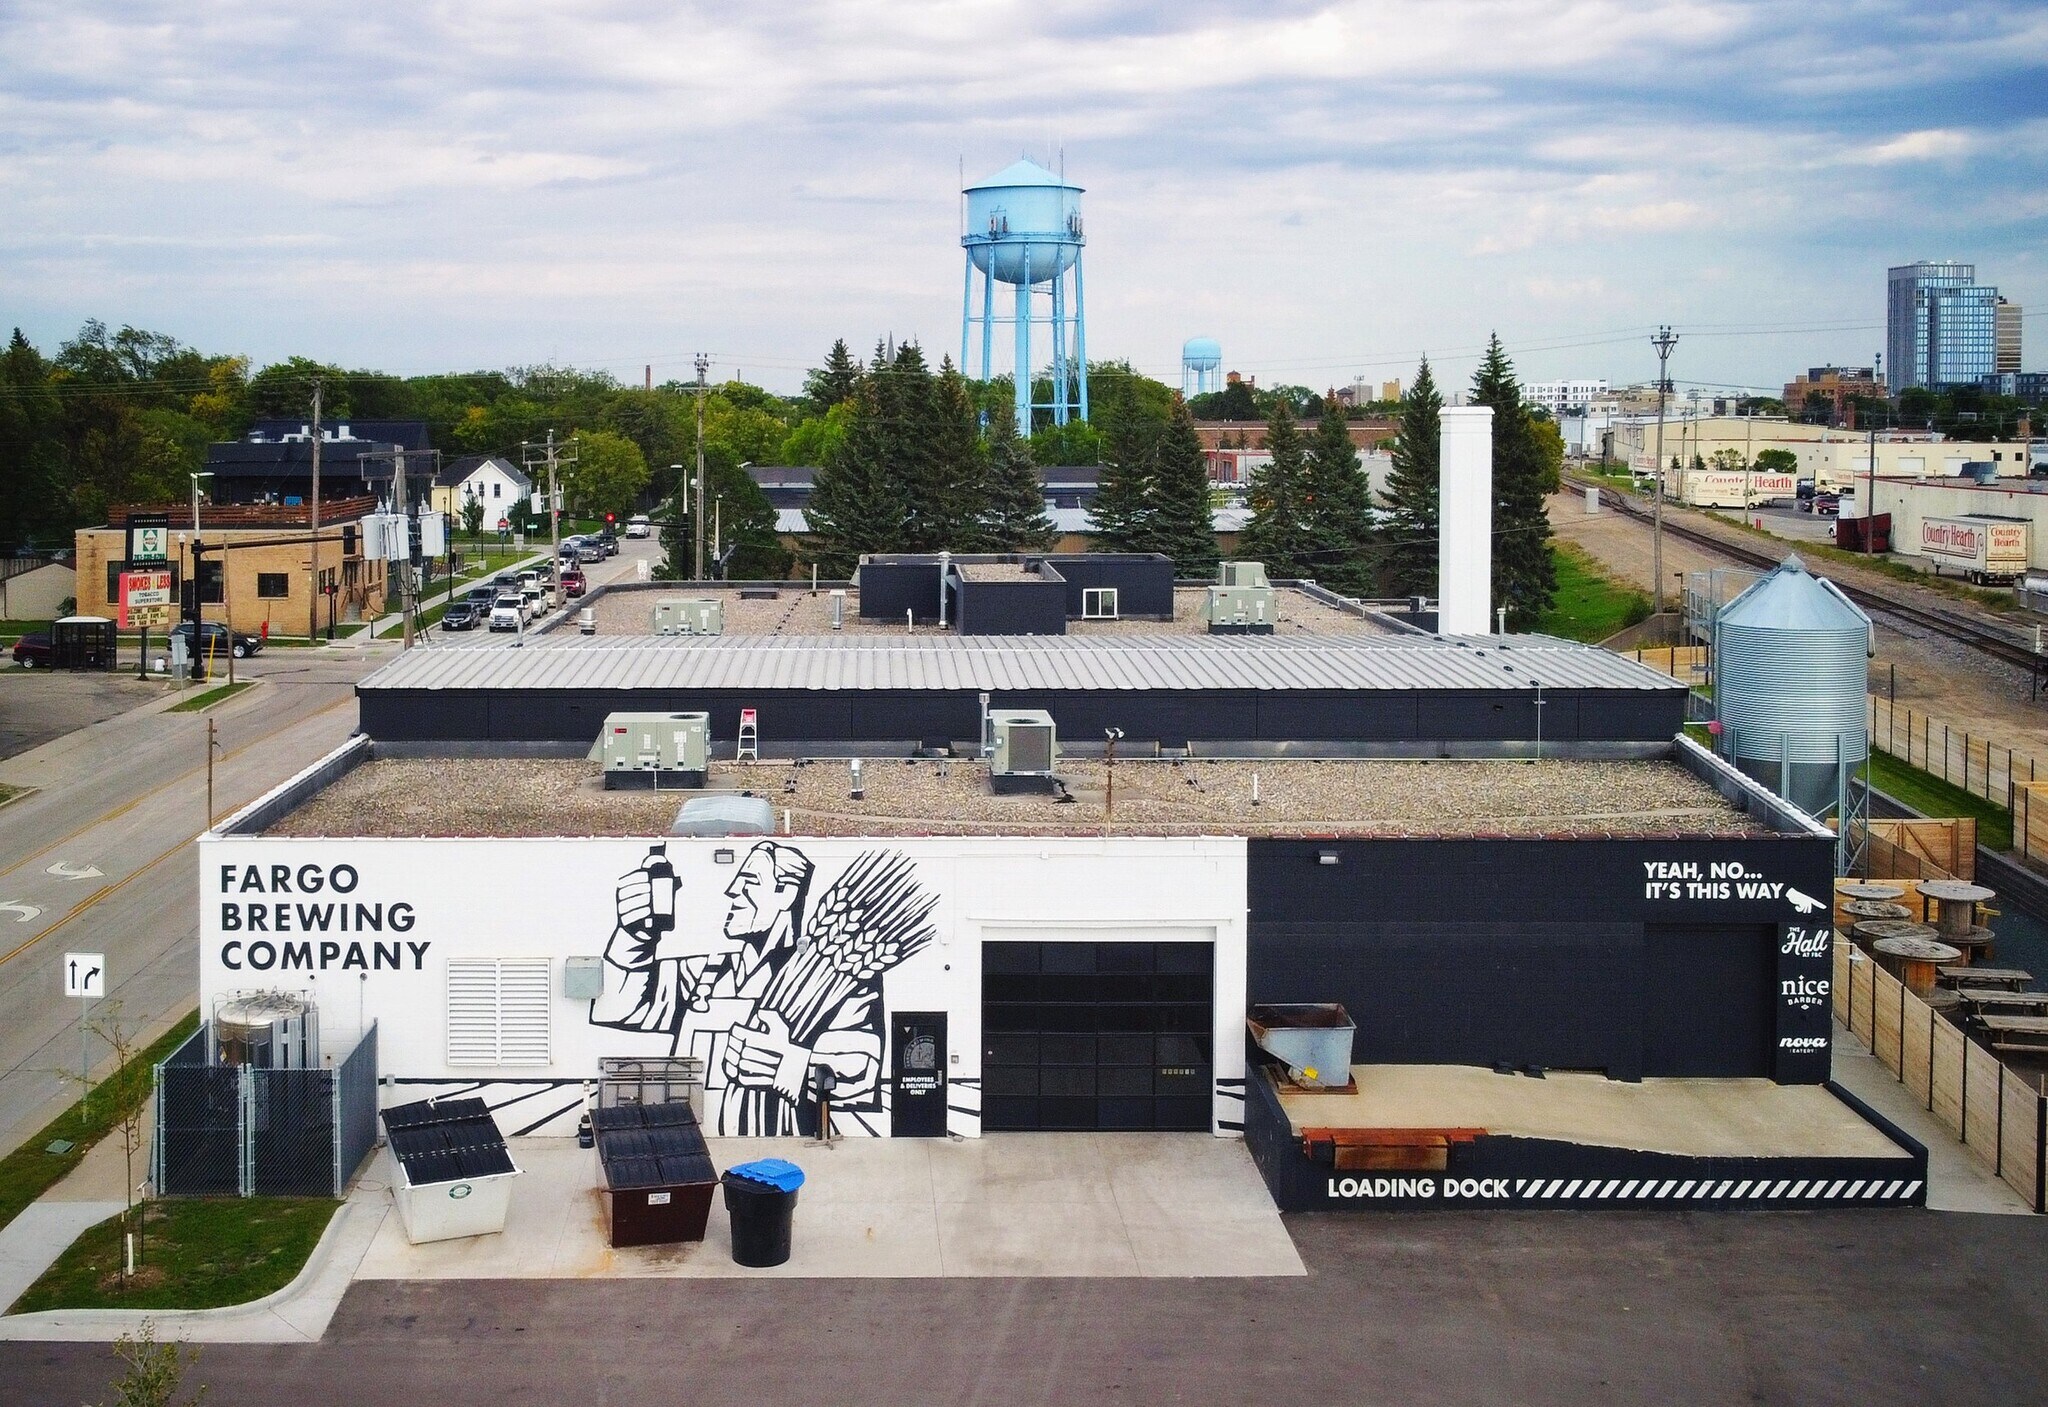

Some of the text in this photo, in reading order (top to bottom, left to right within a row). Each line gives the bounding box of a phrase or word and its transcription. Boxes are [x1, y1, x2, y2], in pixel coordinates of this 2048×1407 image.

[1704, 474, 1792, 488] Countr Hearth
[1922, 521, 1975, 549] Country Hearth
[1990, 526, 2022, 538] Country
[1994, 538, 2020, 547] Hearth
[129, 575, 151, 592] SMOKES
[156, 574, 170, 589] LESS
[220, 863, 359, 894] FARGO
[1643, 862, 1763, 881] YEAH, NO...
[1645, 882, 1784, 899] IT'S THIS WAY
[221, 902, 416, 933] BREWING
[1781, 929, 1830, 956] Hall
[221, 940, 432, 970] COMPANY
[1781, 974, 1830, 996] nice
[1787, 996, 1823, 1006] BARBER
[1779, 1037, 1828, 1048] nova
[1328, 1178, 1510, 1198] LOADING DOCK
